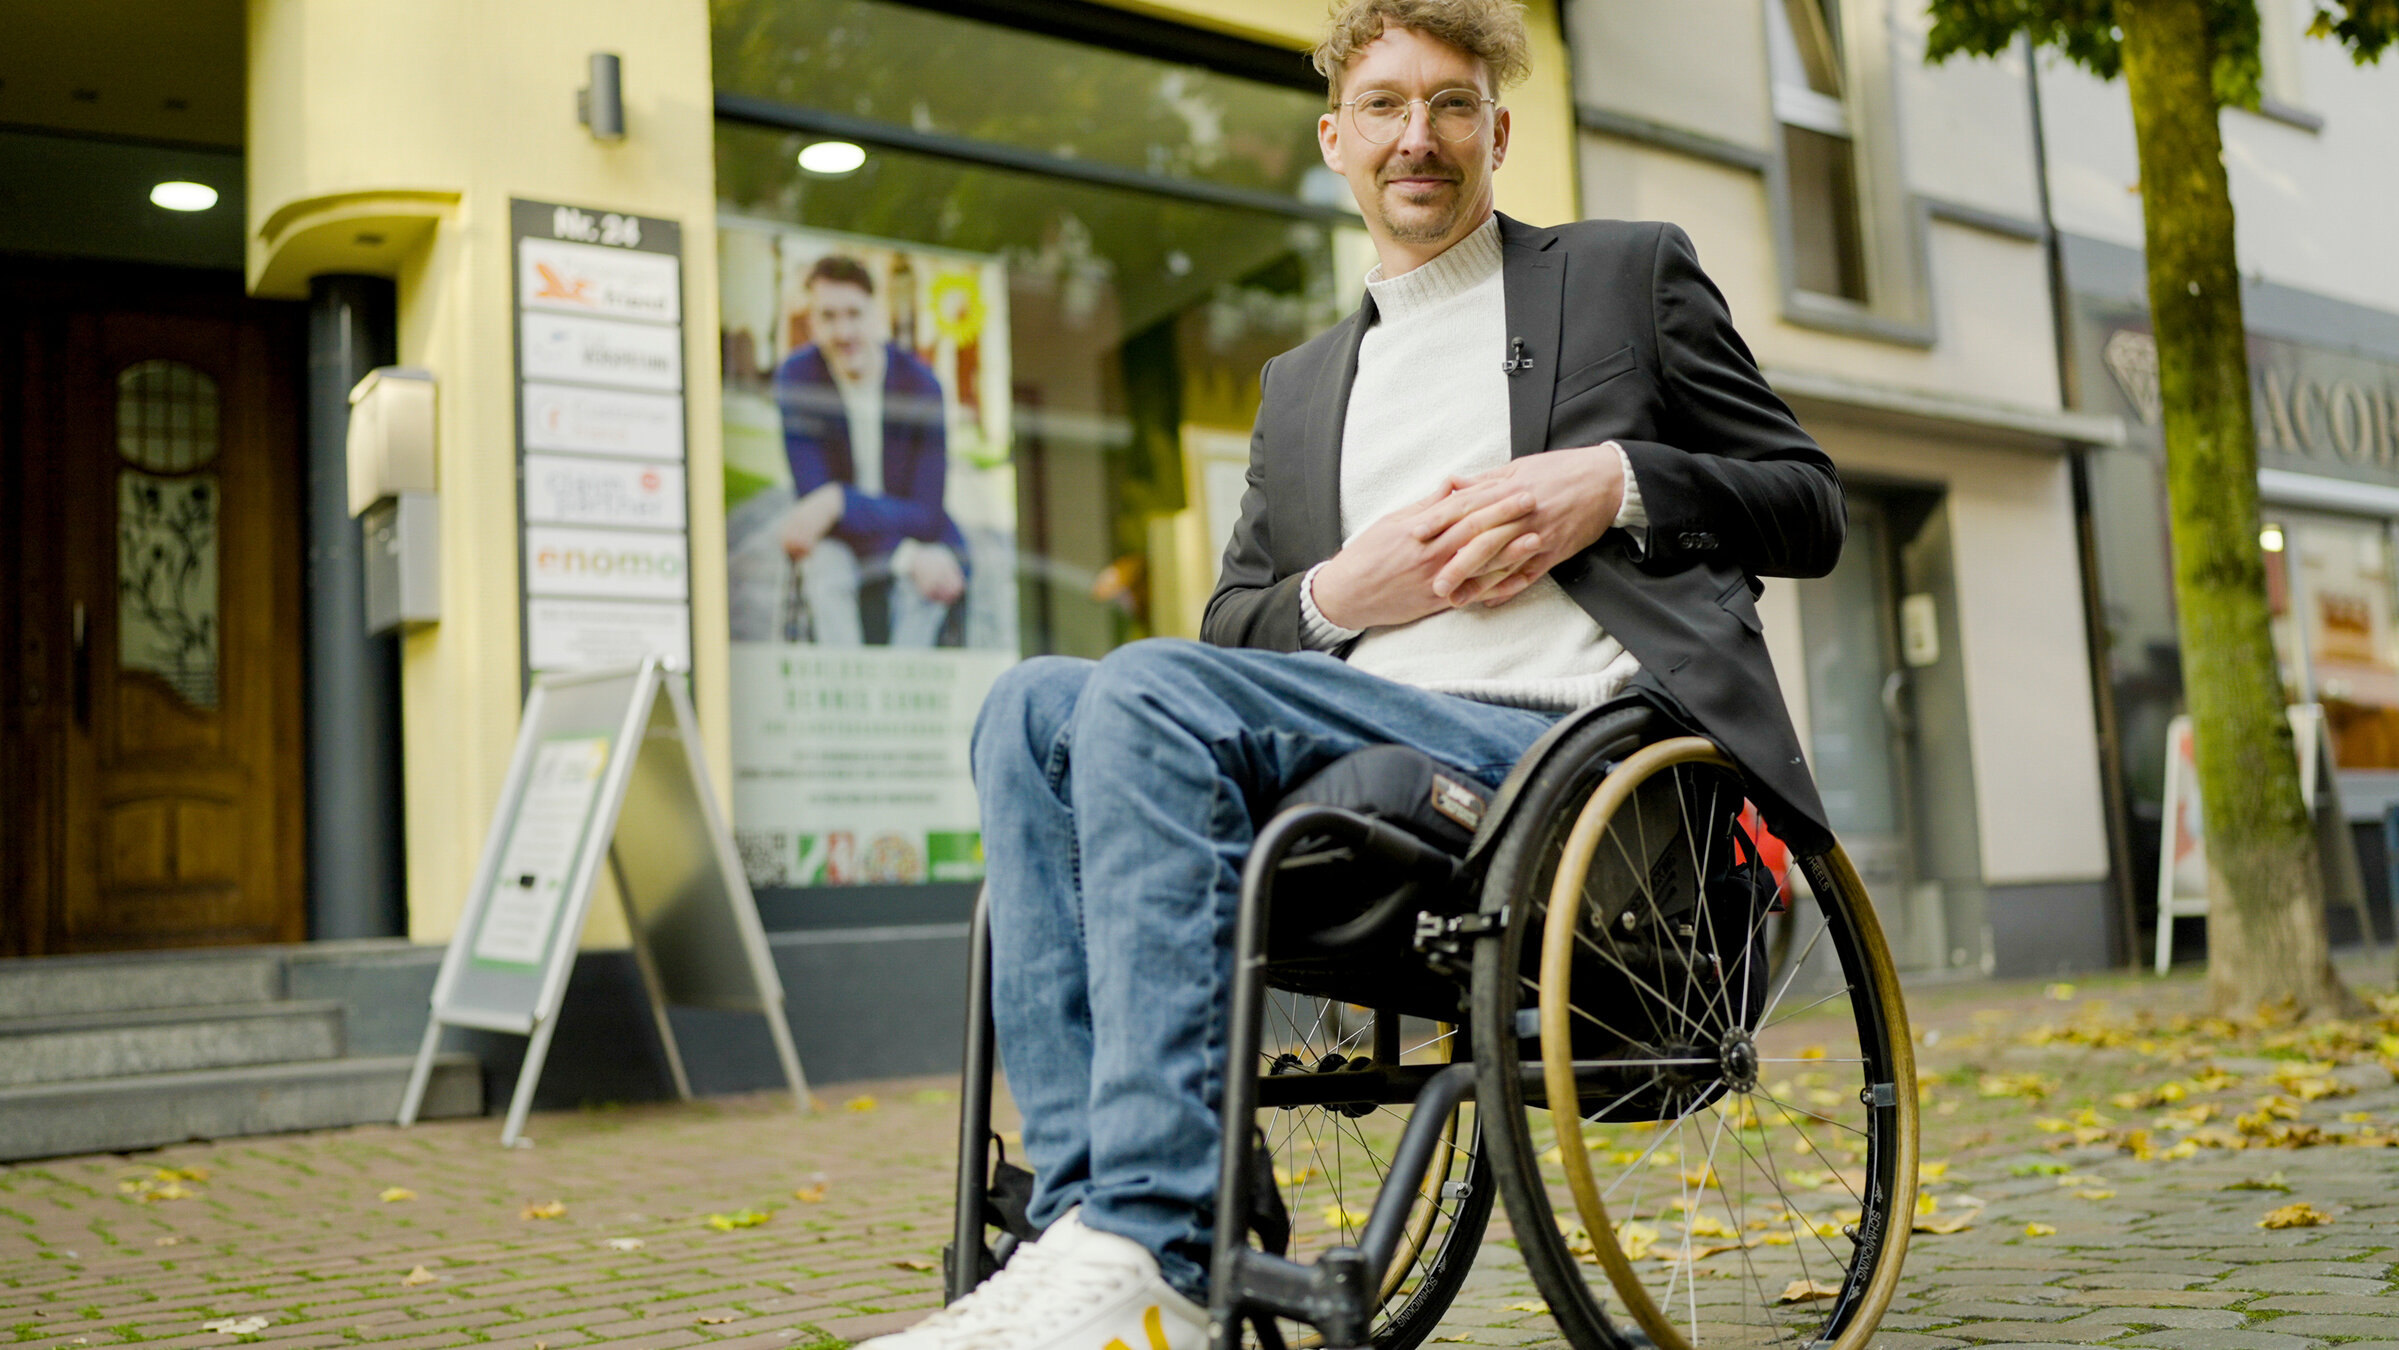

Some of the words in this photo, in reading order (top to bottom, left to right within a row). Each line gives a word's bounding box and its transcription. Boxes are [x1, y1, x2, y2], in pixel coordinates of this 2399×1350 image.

[553, 206, 599, 243] Nr.
[600, 212, 643, 249] 24
[2257, 366, 2399, 465] ACO
[537, 547, 682, 578] enomo
[1857, 1210, 1881, 1281] SCHMICKING
[1397, 1277, 1438, 1327] SCHMICKING
